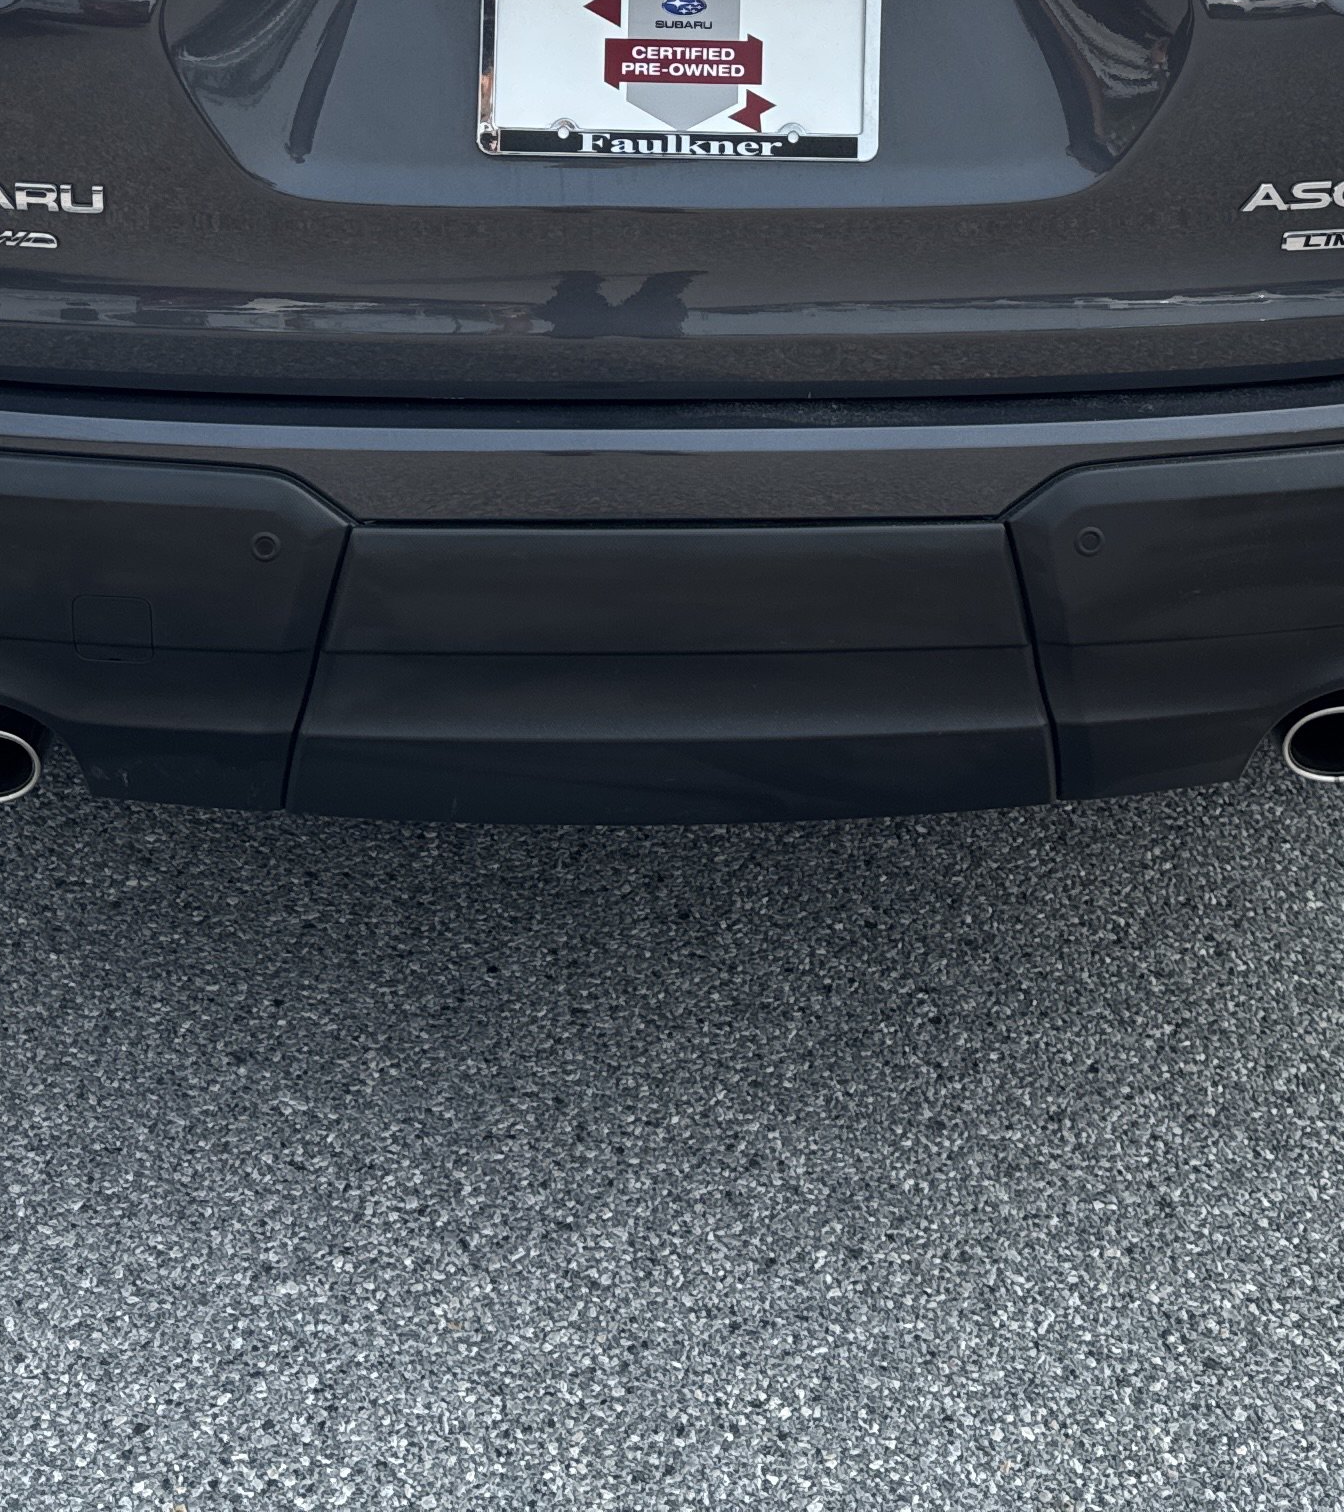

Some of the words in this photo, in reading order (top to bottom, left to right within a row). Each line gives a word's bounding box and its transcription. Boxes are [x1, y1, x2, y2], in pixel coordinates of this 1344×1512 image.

[655, 20, 713, 30] SUBARU
[631, 46, 735, 61] CERTIFIED
[621, 62, 745, 77] PRE-OWNED
[577, 132, 782, 156] Faulkner
